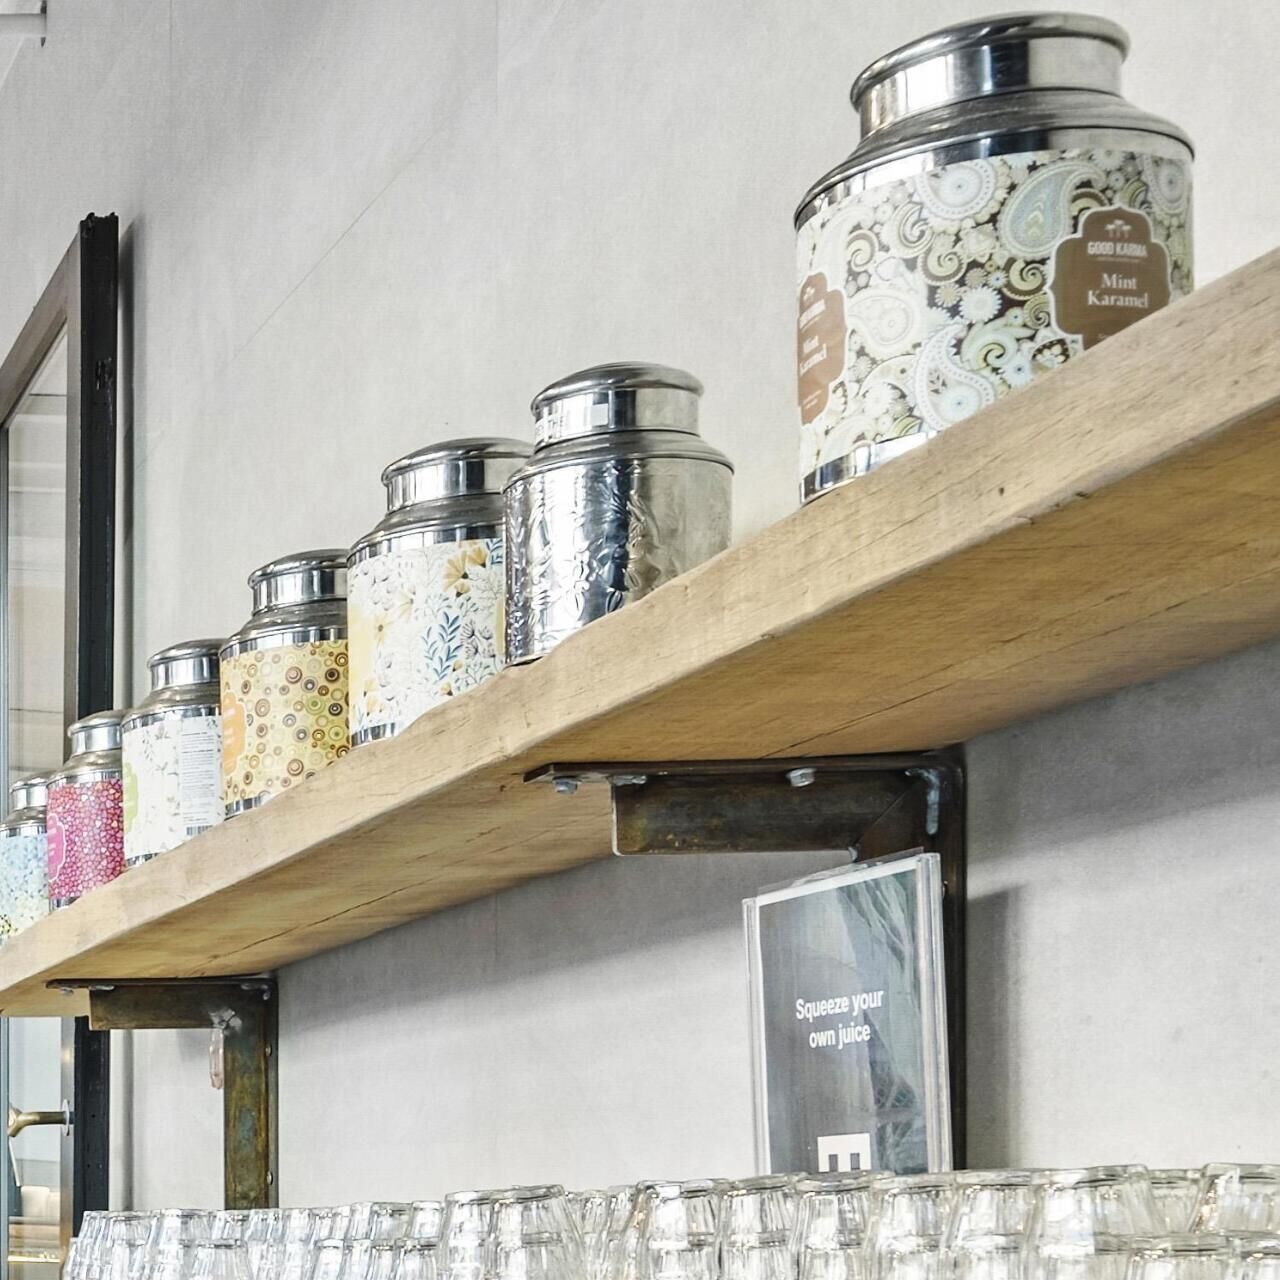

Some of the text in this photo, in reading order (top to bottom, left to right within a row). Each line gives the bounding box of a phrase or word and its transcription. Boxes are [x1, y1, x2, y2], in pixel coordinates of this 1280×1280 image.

[1102, 273, 1137, 289] Mint
[1088, 290, 1149, 309] Karamel
[795, 990, 885, 1023] Squeeze your
[808, 1021, 871, 1050] own juice
